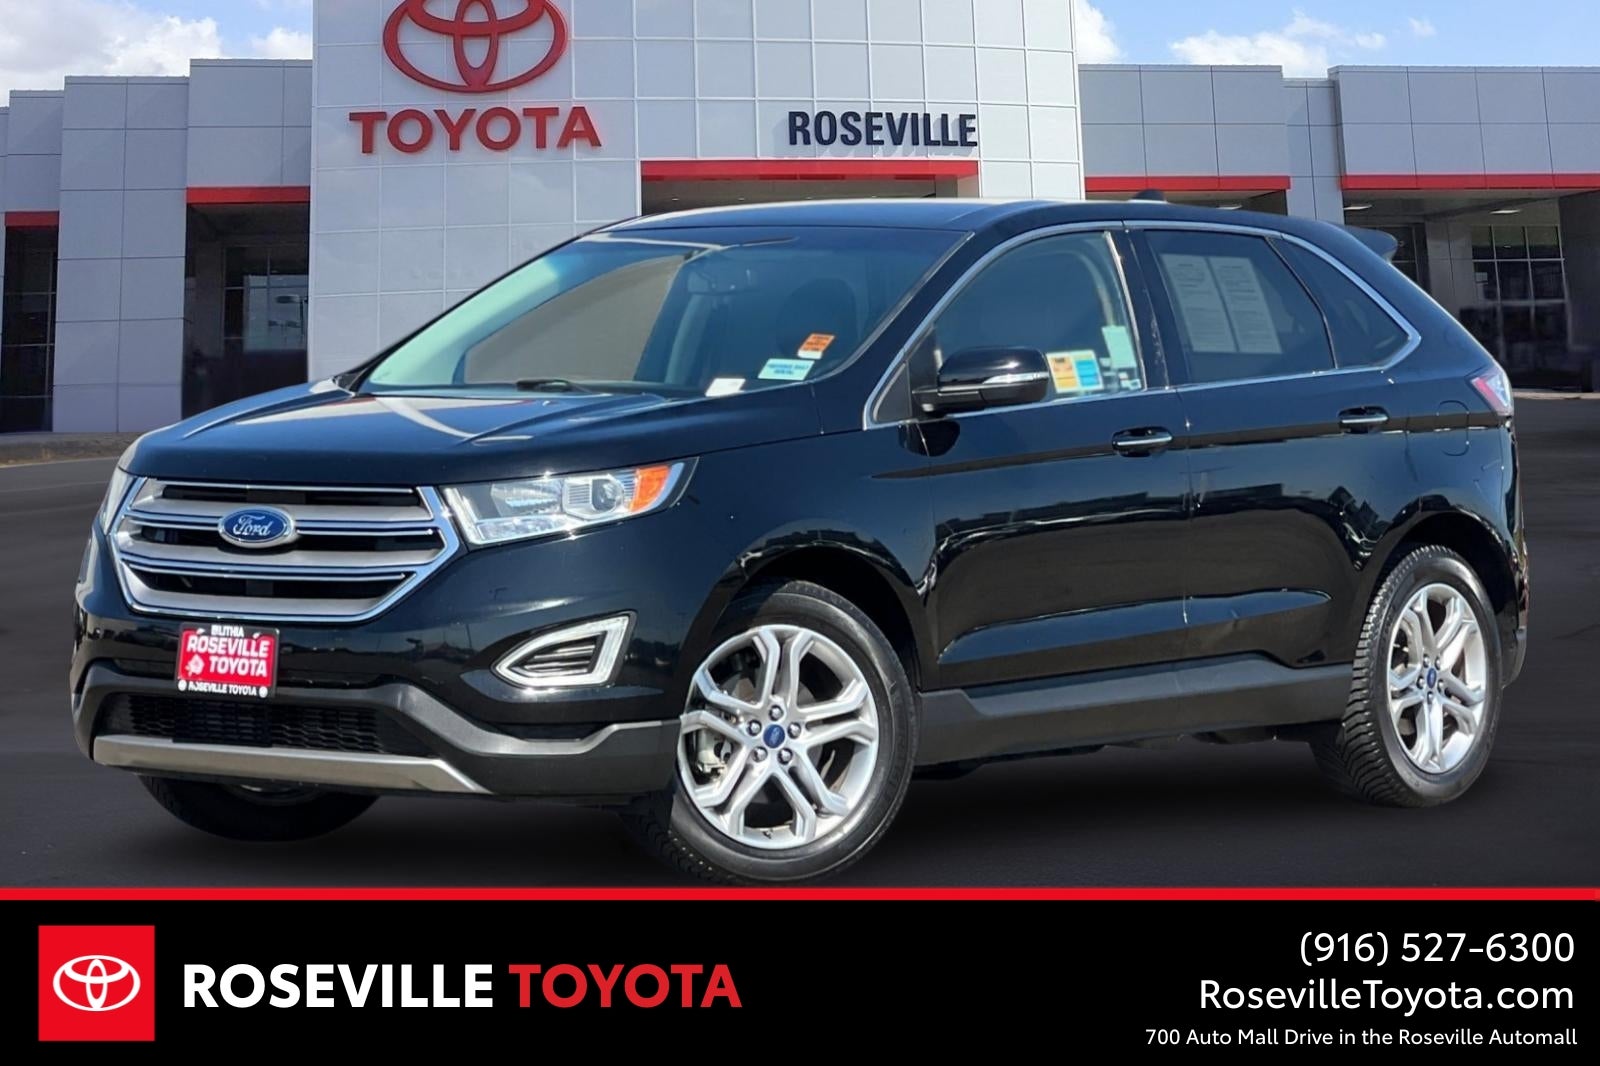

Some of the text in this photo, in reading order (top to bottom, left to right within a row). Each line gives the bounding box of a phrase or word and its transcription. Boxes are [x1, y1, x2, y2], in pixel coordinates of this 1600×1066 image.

[349, 106, 602, 154] TOYOTA
[788, 111, 978, 147] ROSEVILLE
[233, 515, 273, 536] Ford
[187, 635, 270, 658] ROSEVILLE
[209, 656, 267, 677] TOYOTA
[228, 684, 257, 696] TOYOTA
